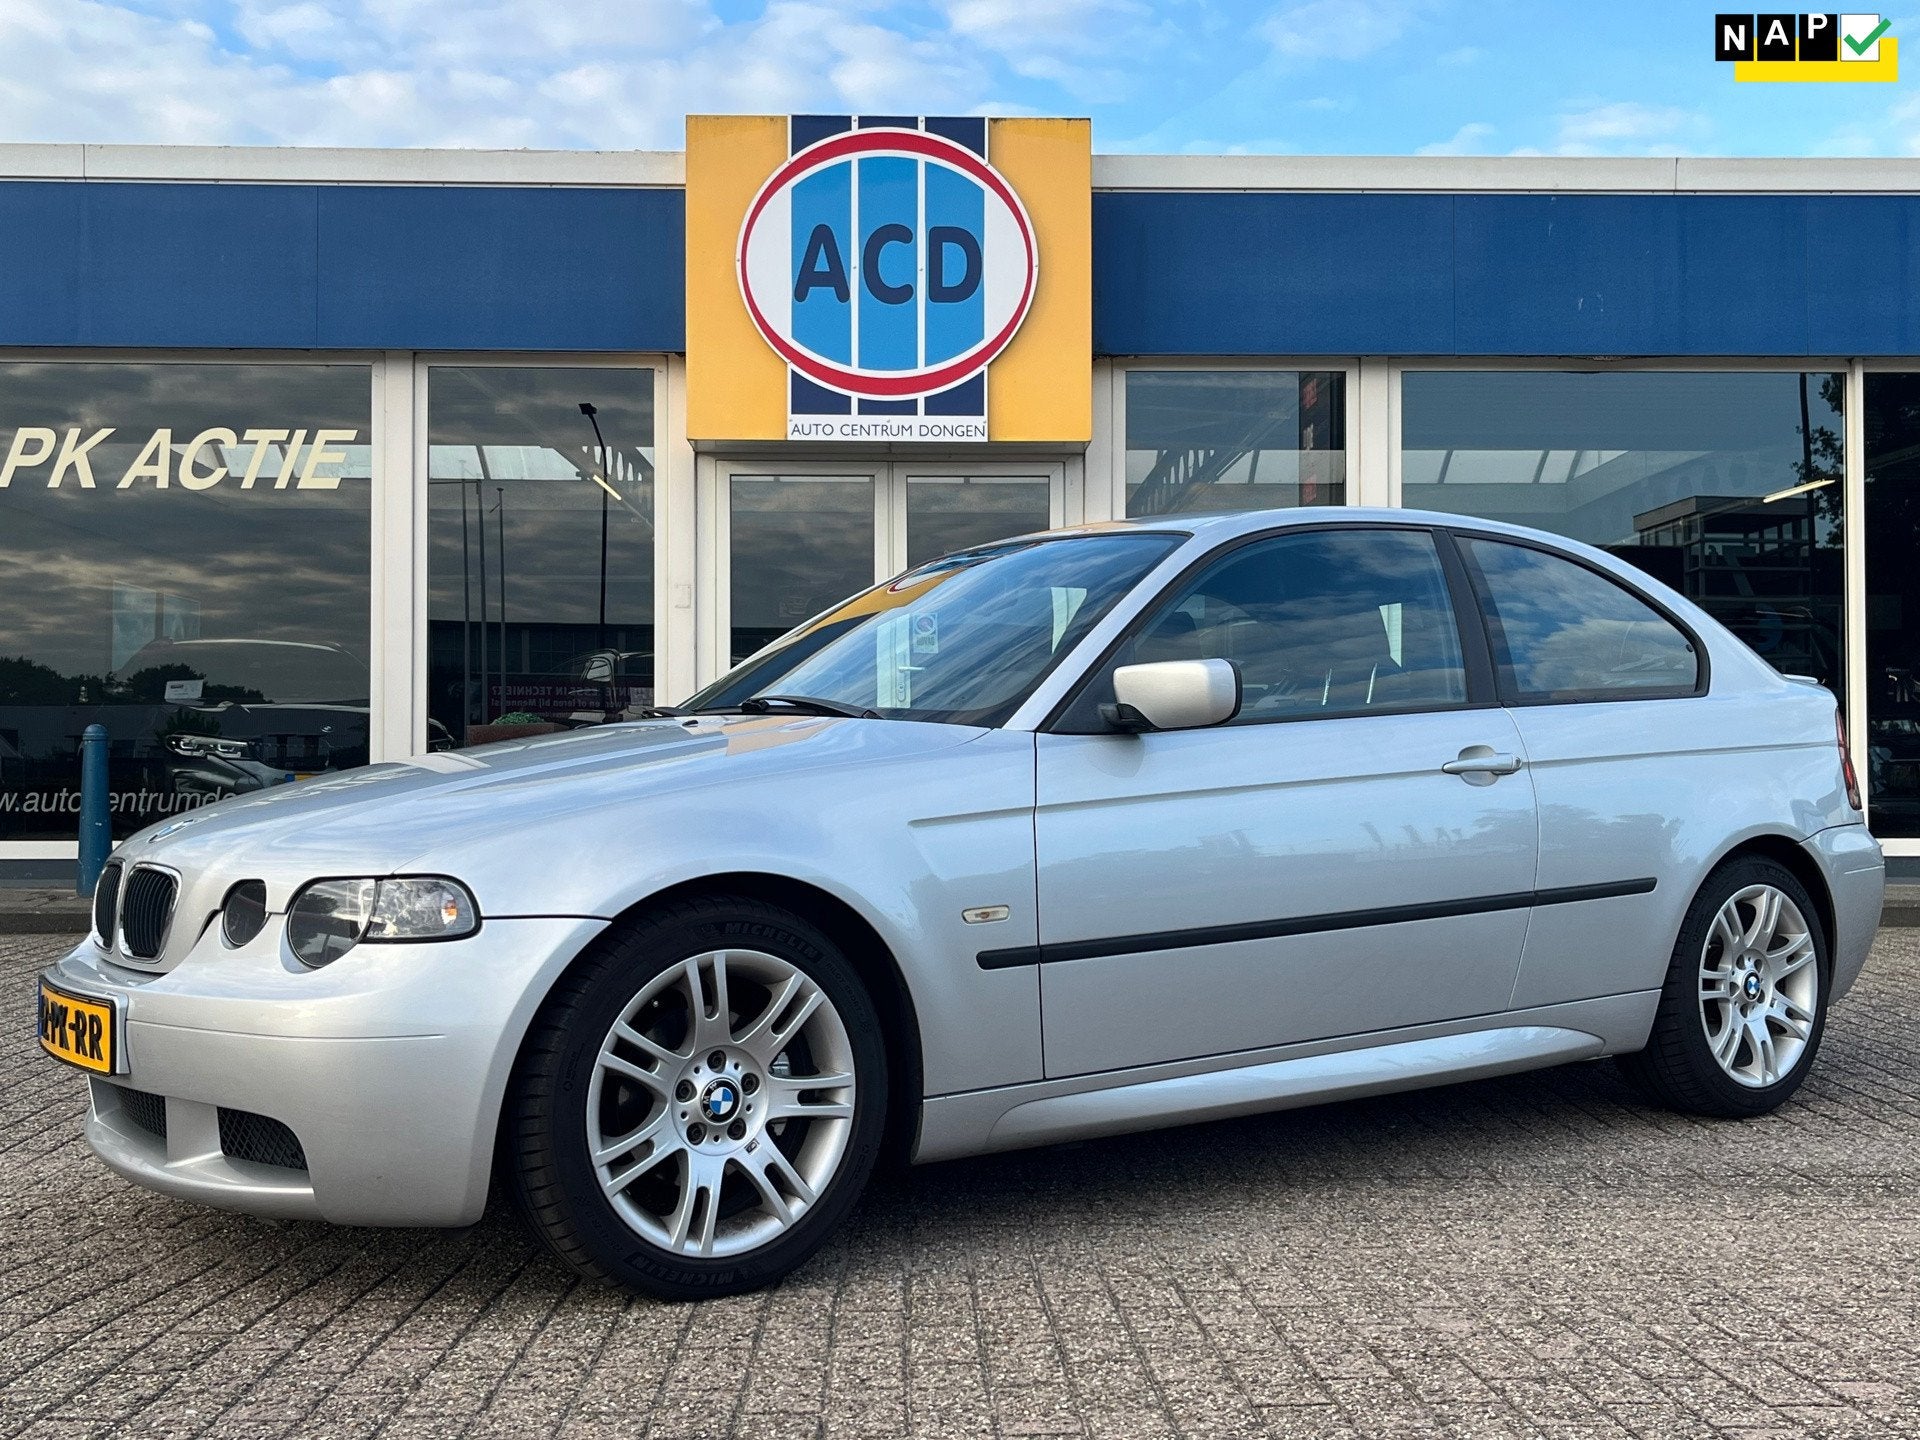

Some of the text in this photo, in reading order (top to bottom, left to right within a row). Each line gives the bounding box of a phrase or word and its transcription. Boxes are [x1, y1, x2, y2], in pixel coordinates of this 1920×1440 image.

[793, 223, 983, 305] ACD
[790, 423, 986, 438] AUTO CENTRUM DONGEN
[0, 427, 358, 490] PK ACTIE
[724, 920, 823, 960] MICHELIN
